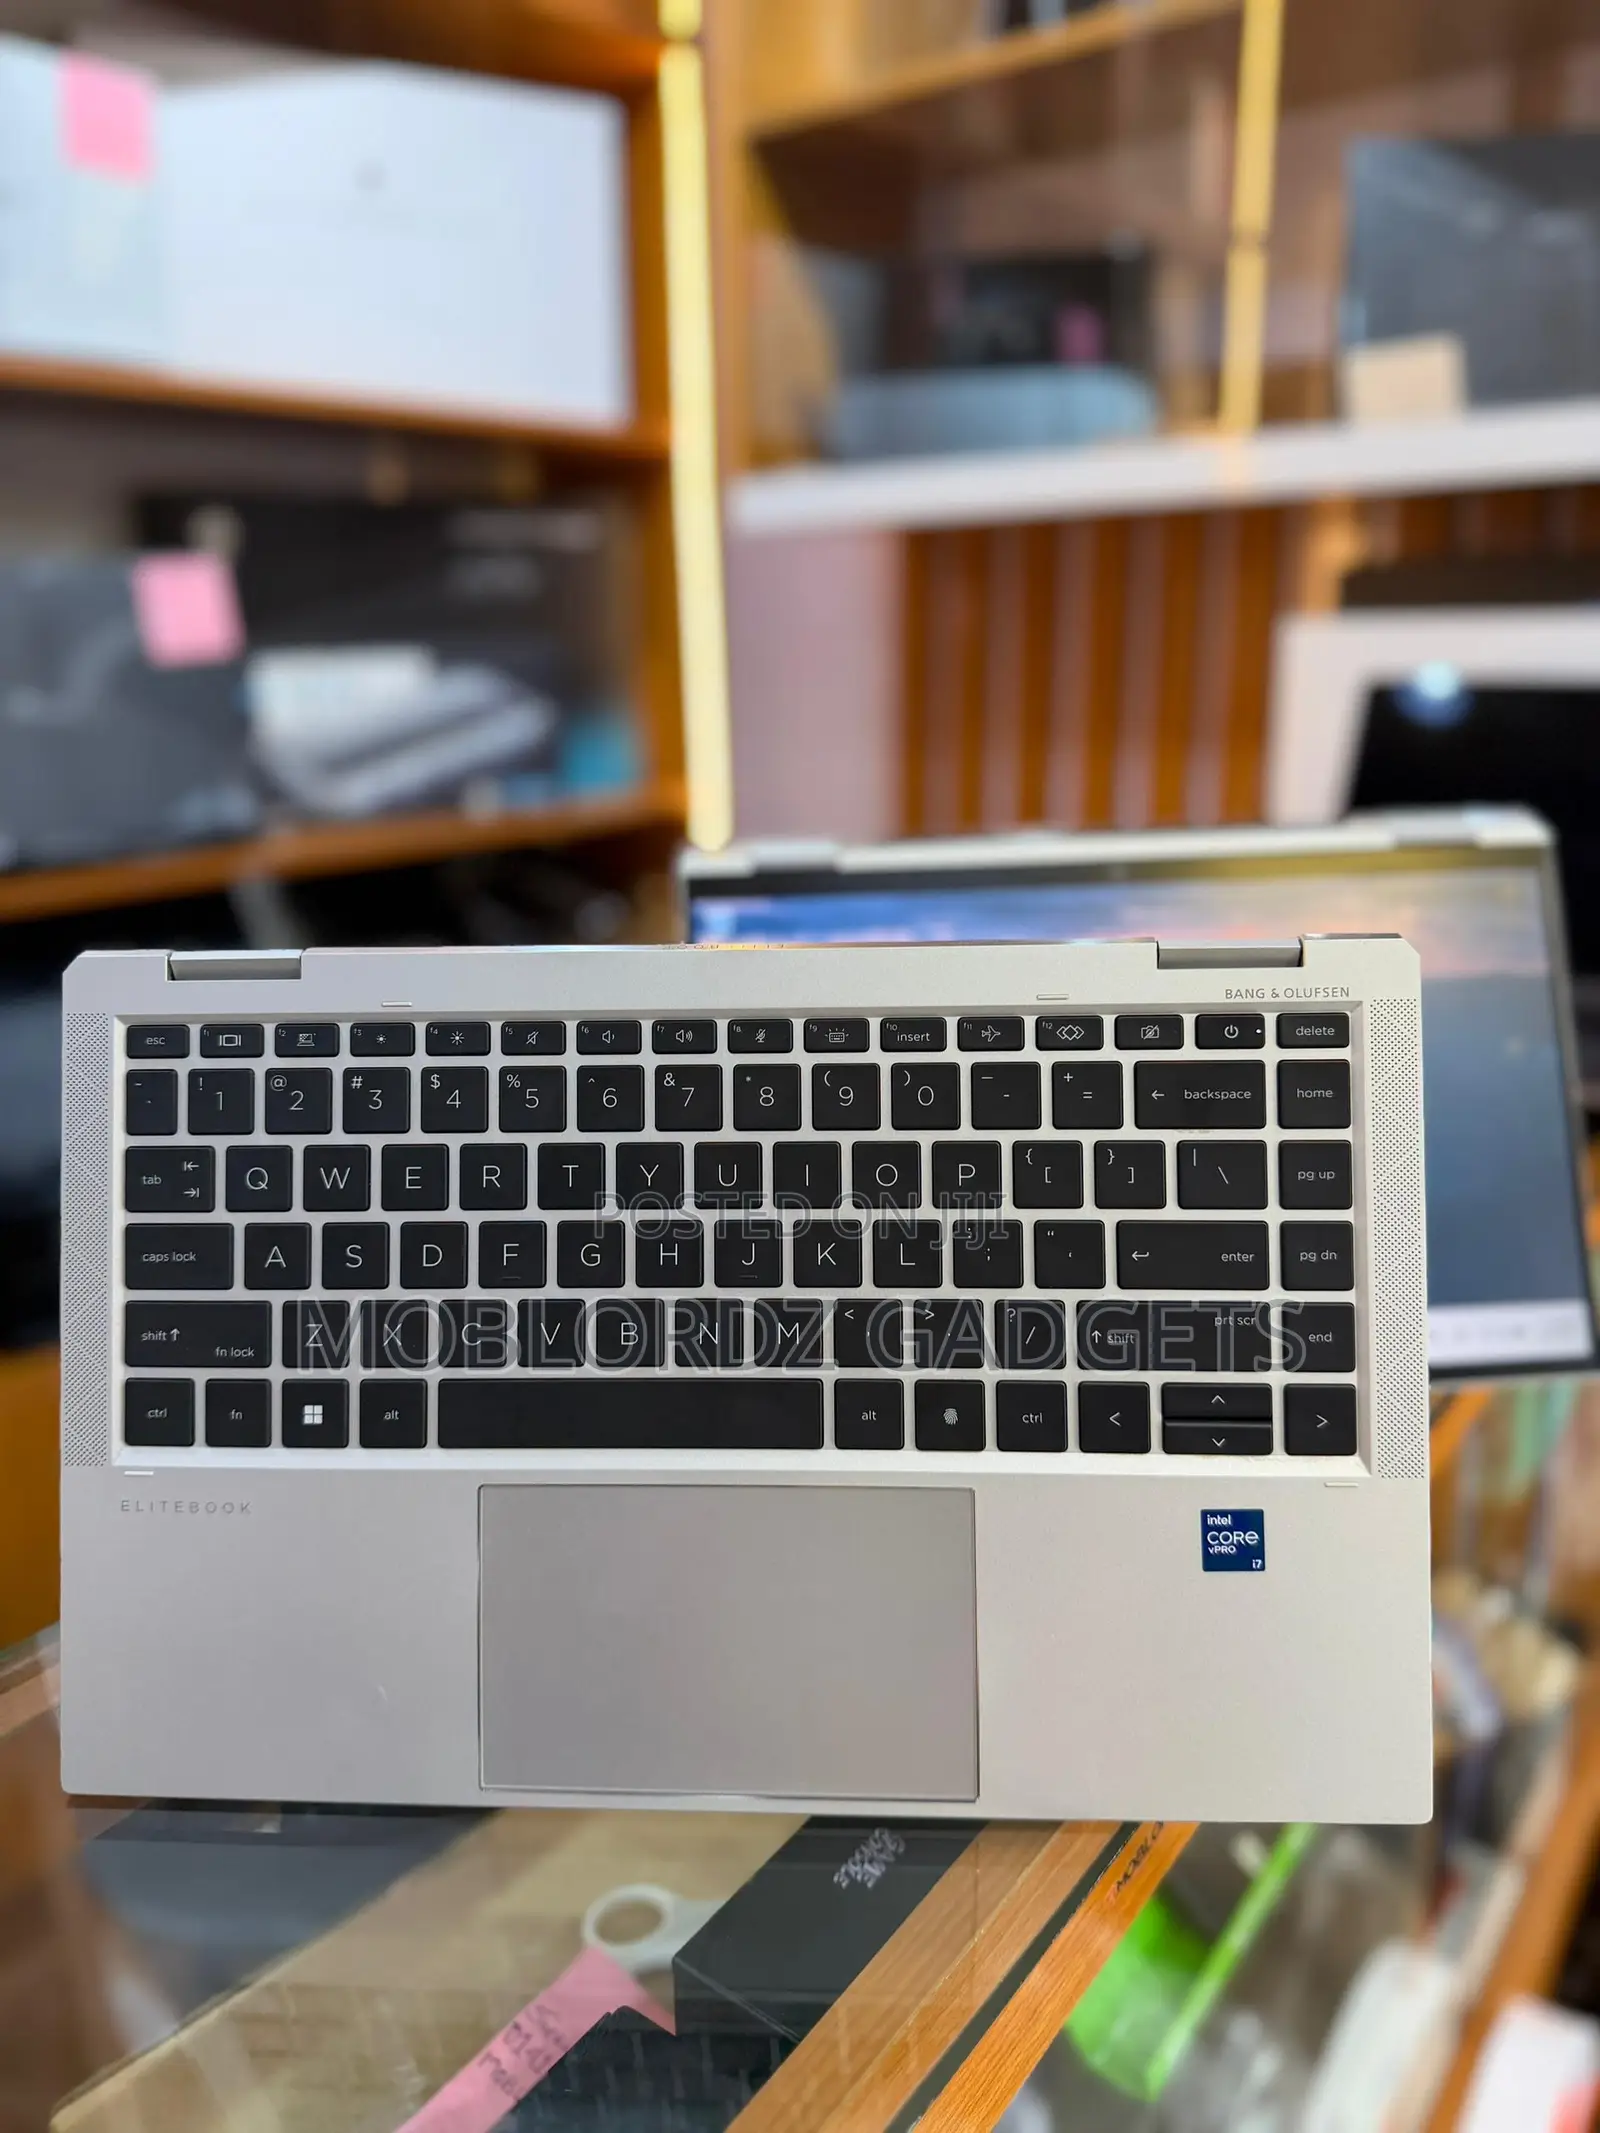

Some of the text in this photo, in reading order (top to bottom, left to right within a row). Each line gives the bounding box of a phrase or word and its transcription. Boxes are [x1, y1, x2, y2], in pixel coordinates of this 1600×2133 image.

[1225, 987, 1349, 999] BANG & OLUFSEN
[897, 1032, 930, 1042] insert
[1295, 1025, 1335, 1037] delete
[145, 1036, 166, 1045] esc
[199, 1077, 203, 1091] !
[270, 1074, 288, 1092] @
[351, 1075, 363, 1089] #
[430, 1073, 441, 1090] $
[506, 1073, 521, 1088] %
[663, 1072, 676, 1087] &
[824, 1070, 831, 1087] (
[904, 1070, 911, 1087] )
[1063, 1072, 1074, 1083] +
[215, 1091, 223, 1111] 1
[289, 1090, 304, 1111] 2
[368, 1089, 383, 1110] 3
[446, 1089, 462, 1109] 4
[525, 1088, 539, 1109] 5
[602, 1087, 618, 1108] 6
[681, 1087, 695, 1107] 7
[759, 1086, 775, 1107] 8
[838, 1086, 854, 1107] 9
[1082, 1091, 1093, 1099] =
[1184, 1088, 1252, 1101] backspace
[1296, 1088, 1334, 1099] home
[1025, 1148, 1033, 1165] {
[1107, 1148, 1115, 1166] }
[142, 1174, 162, 1185] tab
[246, 1166, 269, 1190] Q
[320, 1167, 351, 1190] W
[405, 1166, 422, 1189] E
[482, 1165, 501, 1188] R
[562, 1164, 579, 1188] T
[639, 1164, 659, 1187] Y
[718, 1163, 737, 1187] U
[875, 1163, 898, 1187] O
[958, 1163, 976, 1187] P
[1044, 1166, 1052, 1184] [
[1127, 1166, 1135, 1184] ]
[1217, 1166, 1229, 1185] \
[1297, 1170, 1336, 1181] pg up
[142, 1251, 197, 1263] caps lock
[264, 1245, 287, 1268] A
[345, 1244, 363, 1268] S
[422, 1244, 443, 1267] D
[503, 1243, 520, 1266] F
[580, 1243, 601, 1267] G
[660, 1243, 678, 1266] H
[741, 1242, 755, 1266] J
[817, 1242, 837, 1266] K
[900, 1242, 916, 1266] L
[1221, 1251, 1255, 1262] enter
[1299, 1249, 1337, 1263] pg dn
[844, 1309, 854, 1320] <
[924, 1308, 935, 1320] >
[1006, 1308, 1016, 1323] ?
[1215, 1316, 1256, 1327] prt scr
[141, 1330, 167, 1341] shift
[305, 1323, 323, 1347] Z
[383, 1323, 402, 1347] X
[461, 1322, 482, 1346] C
[540, 1322, 561, 1346] V
[620, 1321, 639, 1346] B
[699, 1321, 719, 1345] N
[777, 1322, 800, 1346] M
[1025, 1326, 1036, 1345] /
[1107, 1333, 1134, 1344] shift
[1308, 1331, 1333, 1343] end
[215, 1346, 255, 1358] fn lock
[147, 1408, 167, 1418] ctrl
[231, 1408, 243, 1420] fn
[383, 1409, 399, 1421] alt
[861, 1410, 877, 1421] alt
[1022, 1412, 1043, 1424] ctrl
[120, 1499, 252, 1514] ELITEBOOK
[1207, 1515, 1231, 1525] intel
[1253, 1560, 1261, 1568] i7
